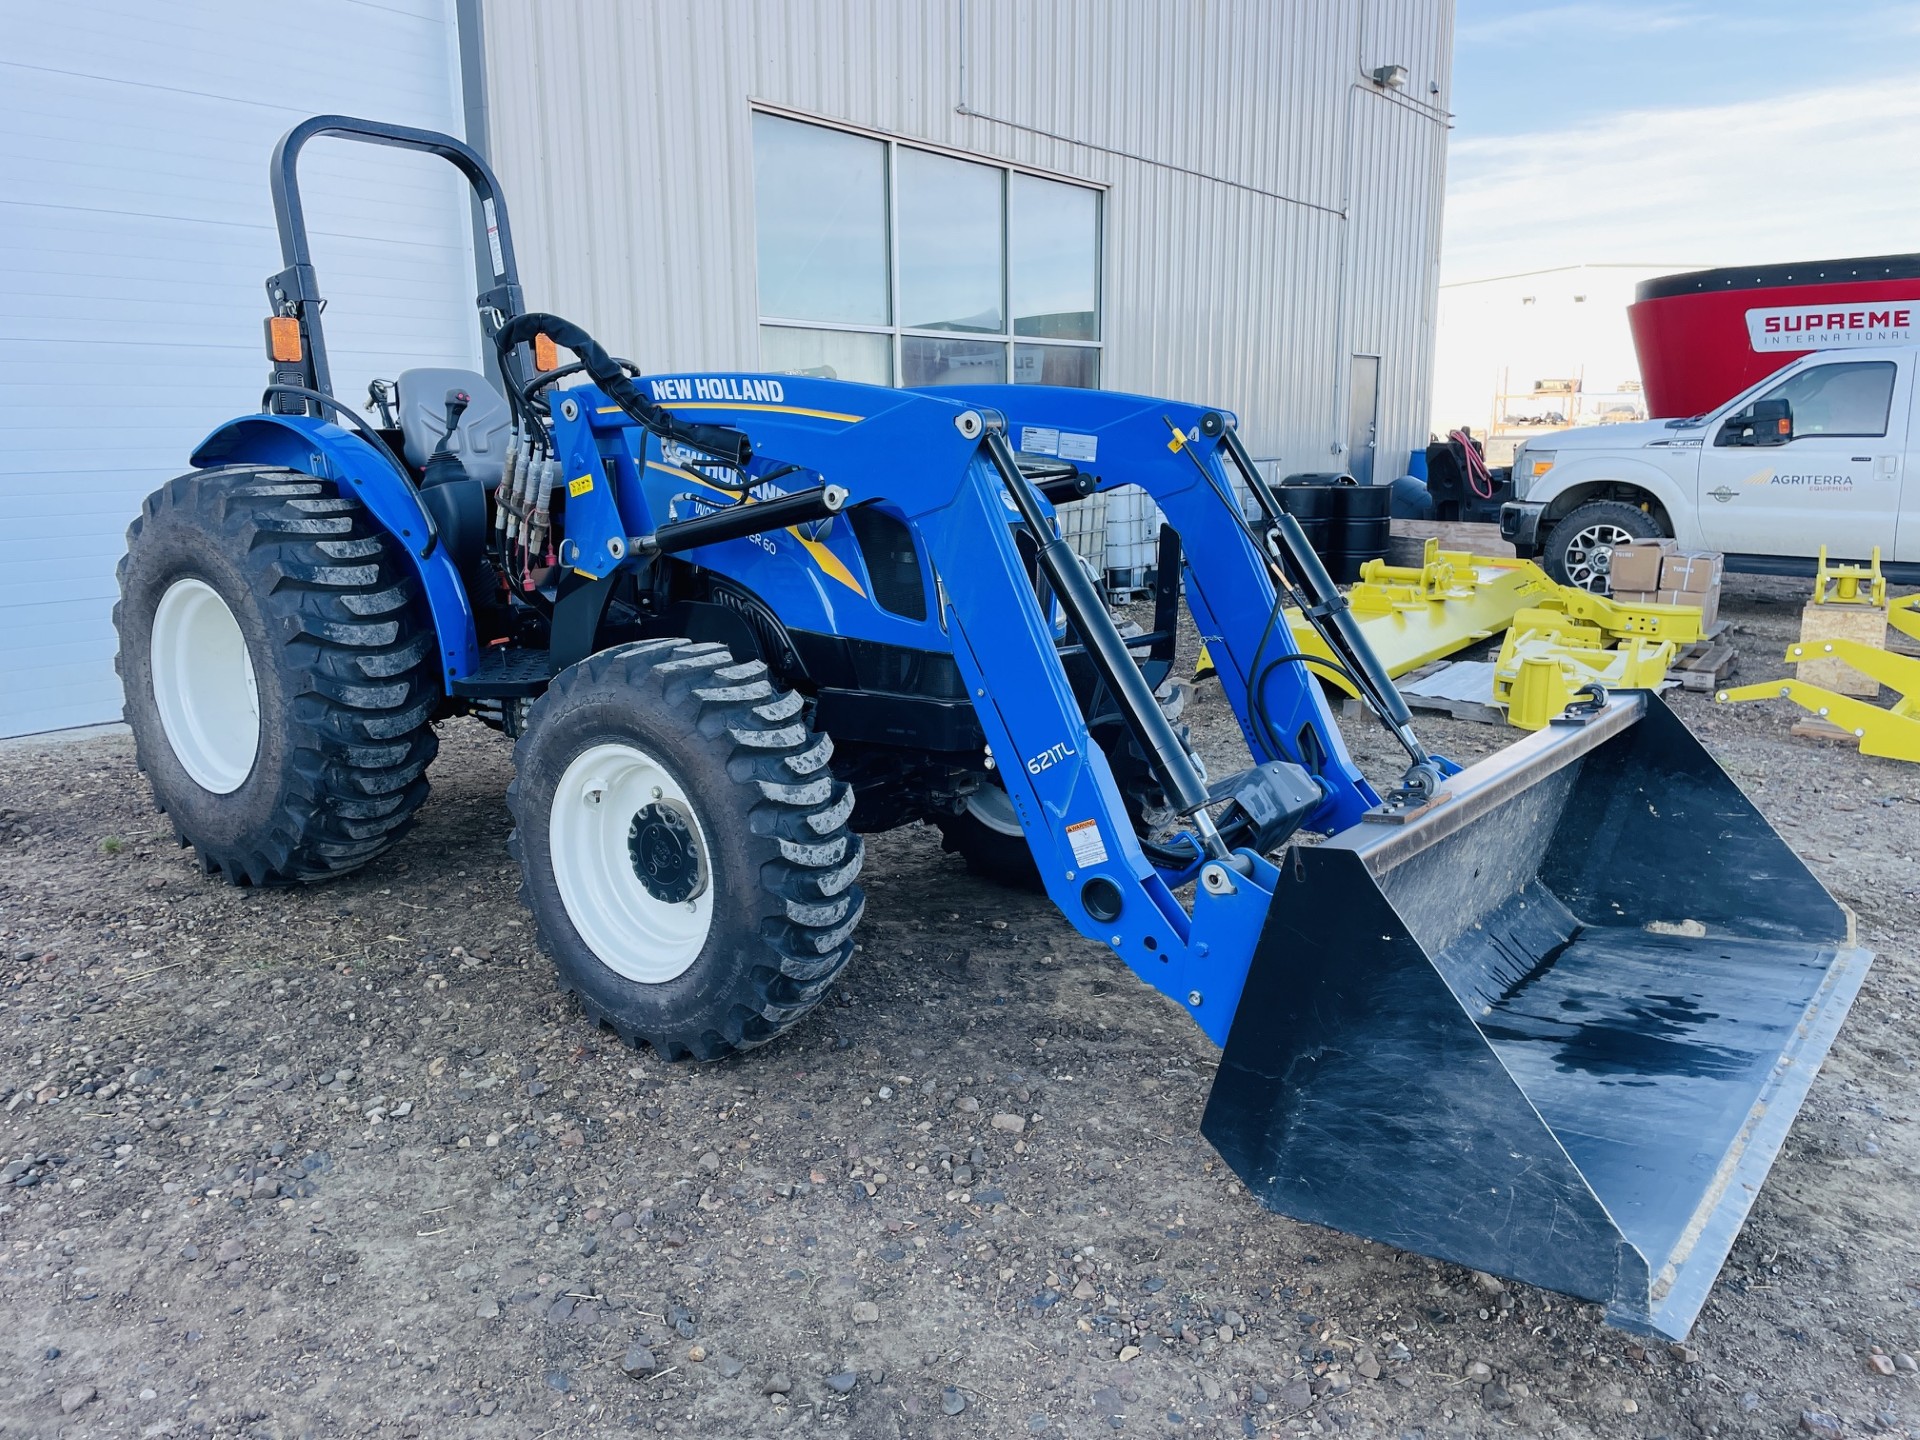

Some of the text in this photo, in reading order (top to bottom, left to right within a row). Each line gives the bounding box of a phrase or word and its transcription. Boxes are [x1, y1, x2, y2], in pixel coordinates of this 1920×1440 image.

[1764, 310, 1911, 333] SUPREME
[1764, 331, 1911, 345] INTERNATIONAL
[651, 378, 784, 403] NEW HOLLAND
[703, 456, 789, 500] HOLAN
[1770, 475, 1853, 485] AGRITERRA
[762, 538, 777, 556] 60
